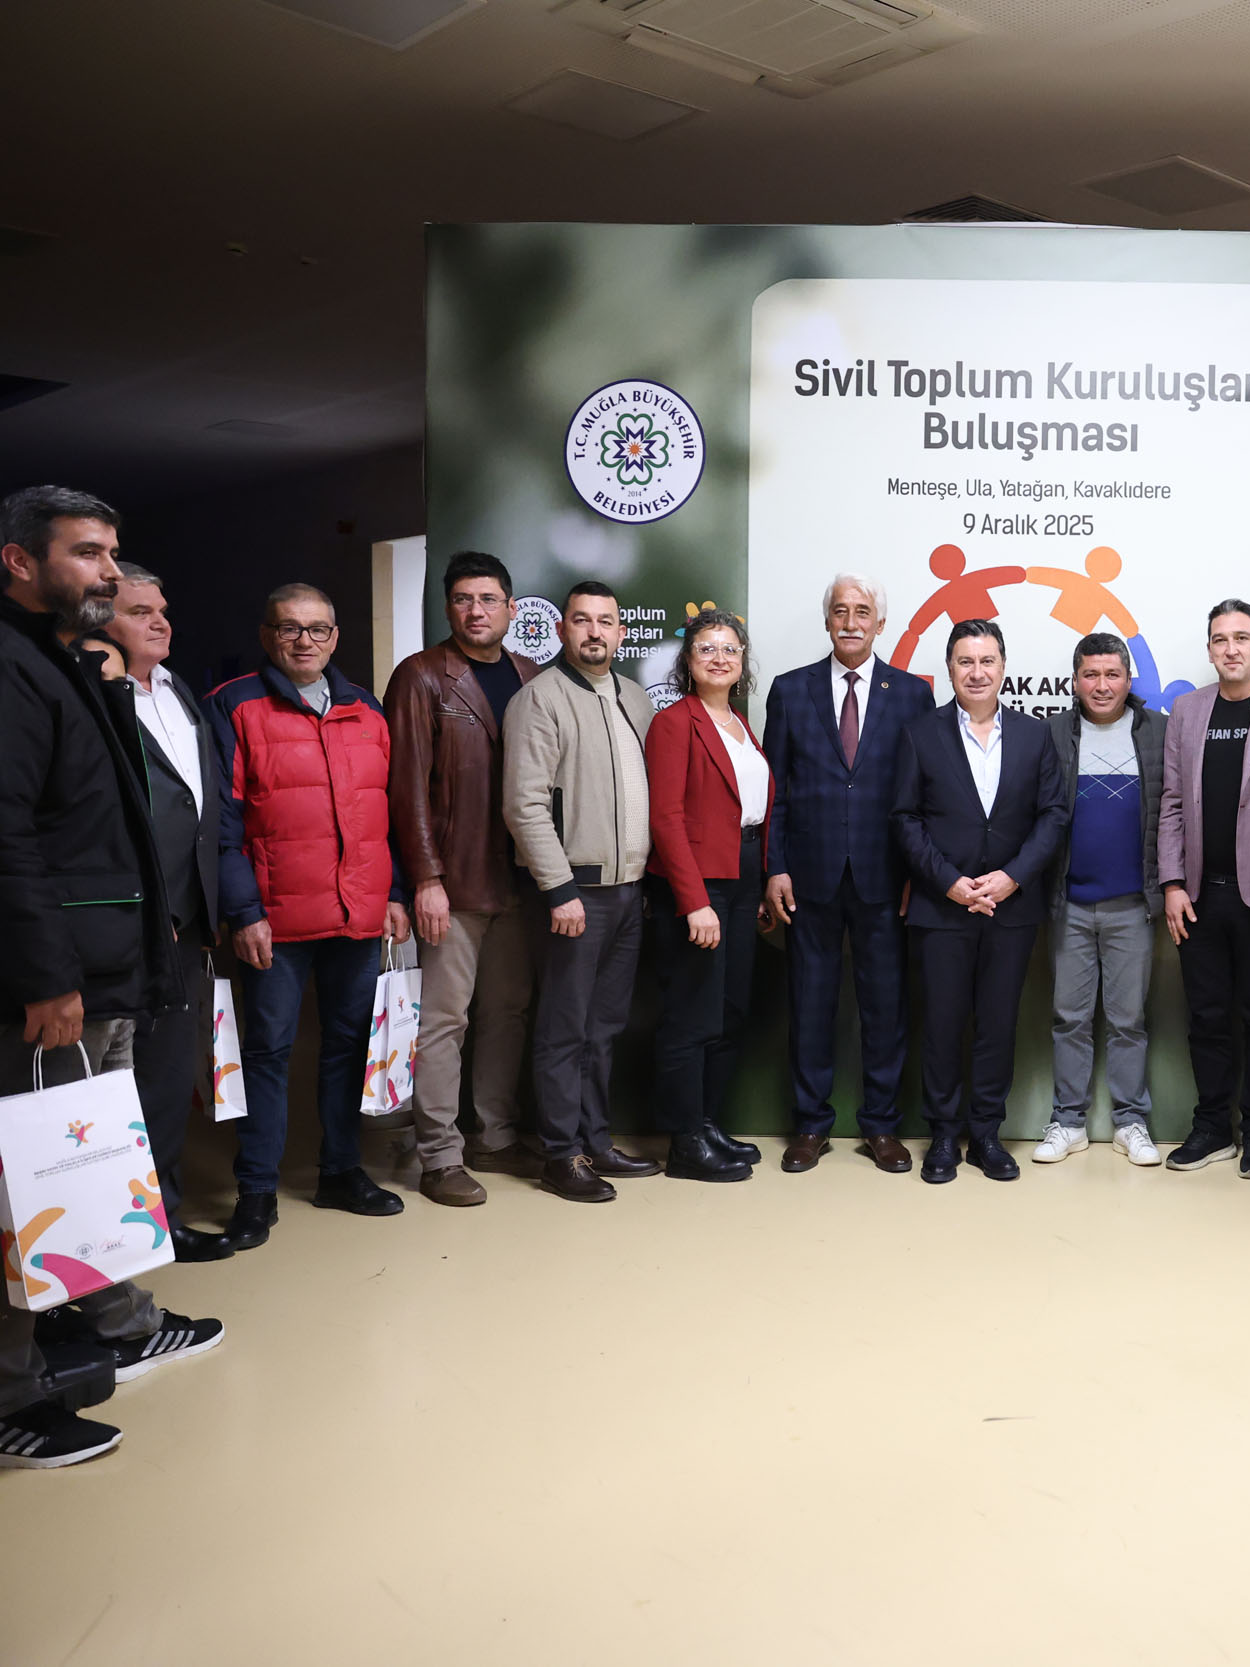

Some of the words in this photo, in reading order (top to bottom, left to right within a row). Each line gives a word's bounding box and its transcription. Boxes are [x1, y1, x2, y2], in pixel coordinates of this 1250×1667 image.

[794, 358, 878, 397] Sivil
[887, 359, 1033, 406] Toplum
[632, 388, 697, 460] BÜYÜKŞEHİR
[923, 411, 1138, 462] Buluşması
[627, 490, 642, 498] 2014
[887, 477, 961, 500] Menteşe,
[966, 478, 996, 499] Ula,
[1000, 479, 1069, 503] Yatağan,
[1073, 480, 1172, 499] Kavaklıdere
[593, 489, 676, 516] BELEDİYESİ
[963, 512, 976, 534] 9
[980, 513, 1039, 535] Aralık
[1043, 513, 1094, 536] 2025
[619, 605, 666, 624] oplum
[624, 624, 664, 643] uşları
[1000, 676, 1034, 696] AK
[1206, 728, 1231, 740] FIAN
[1233, 727, 1248, 739] SP
